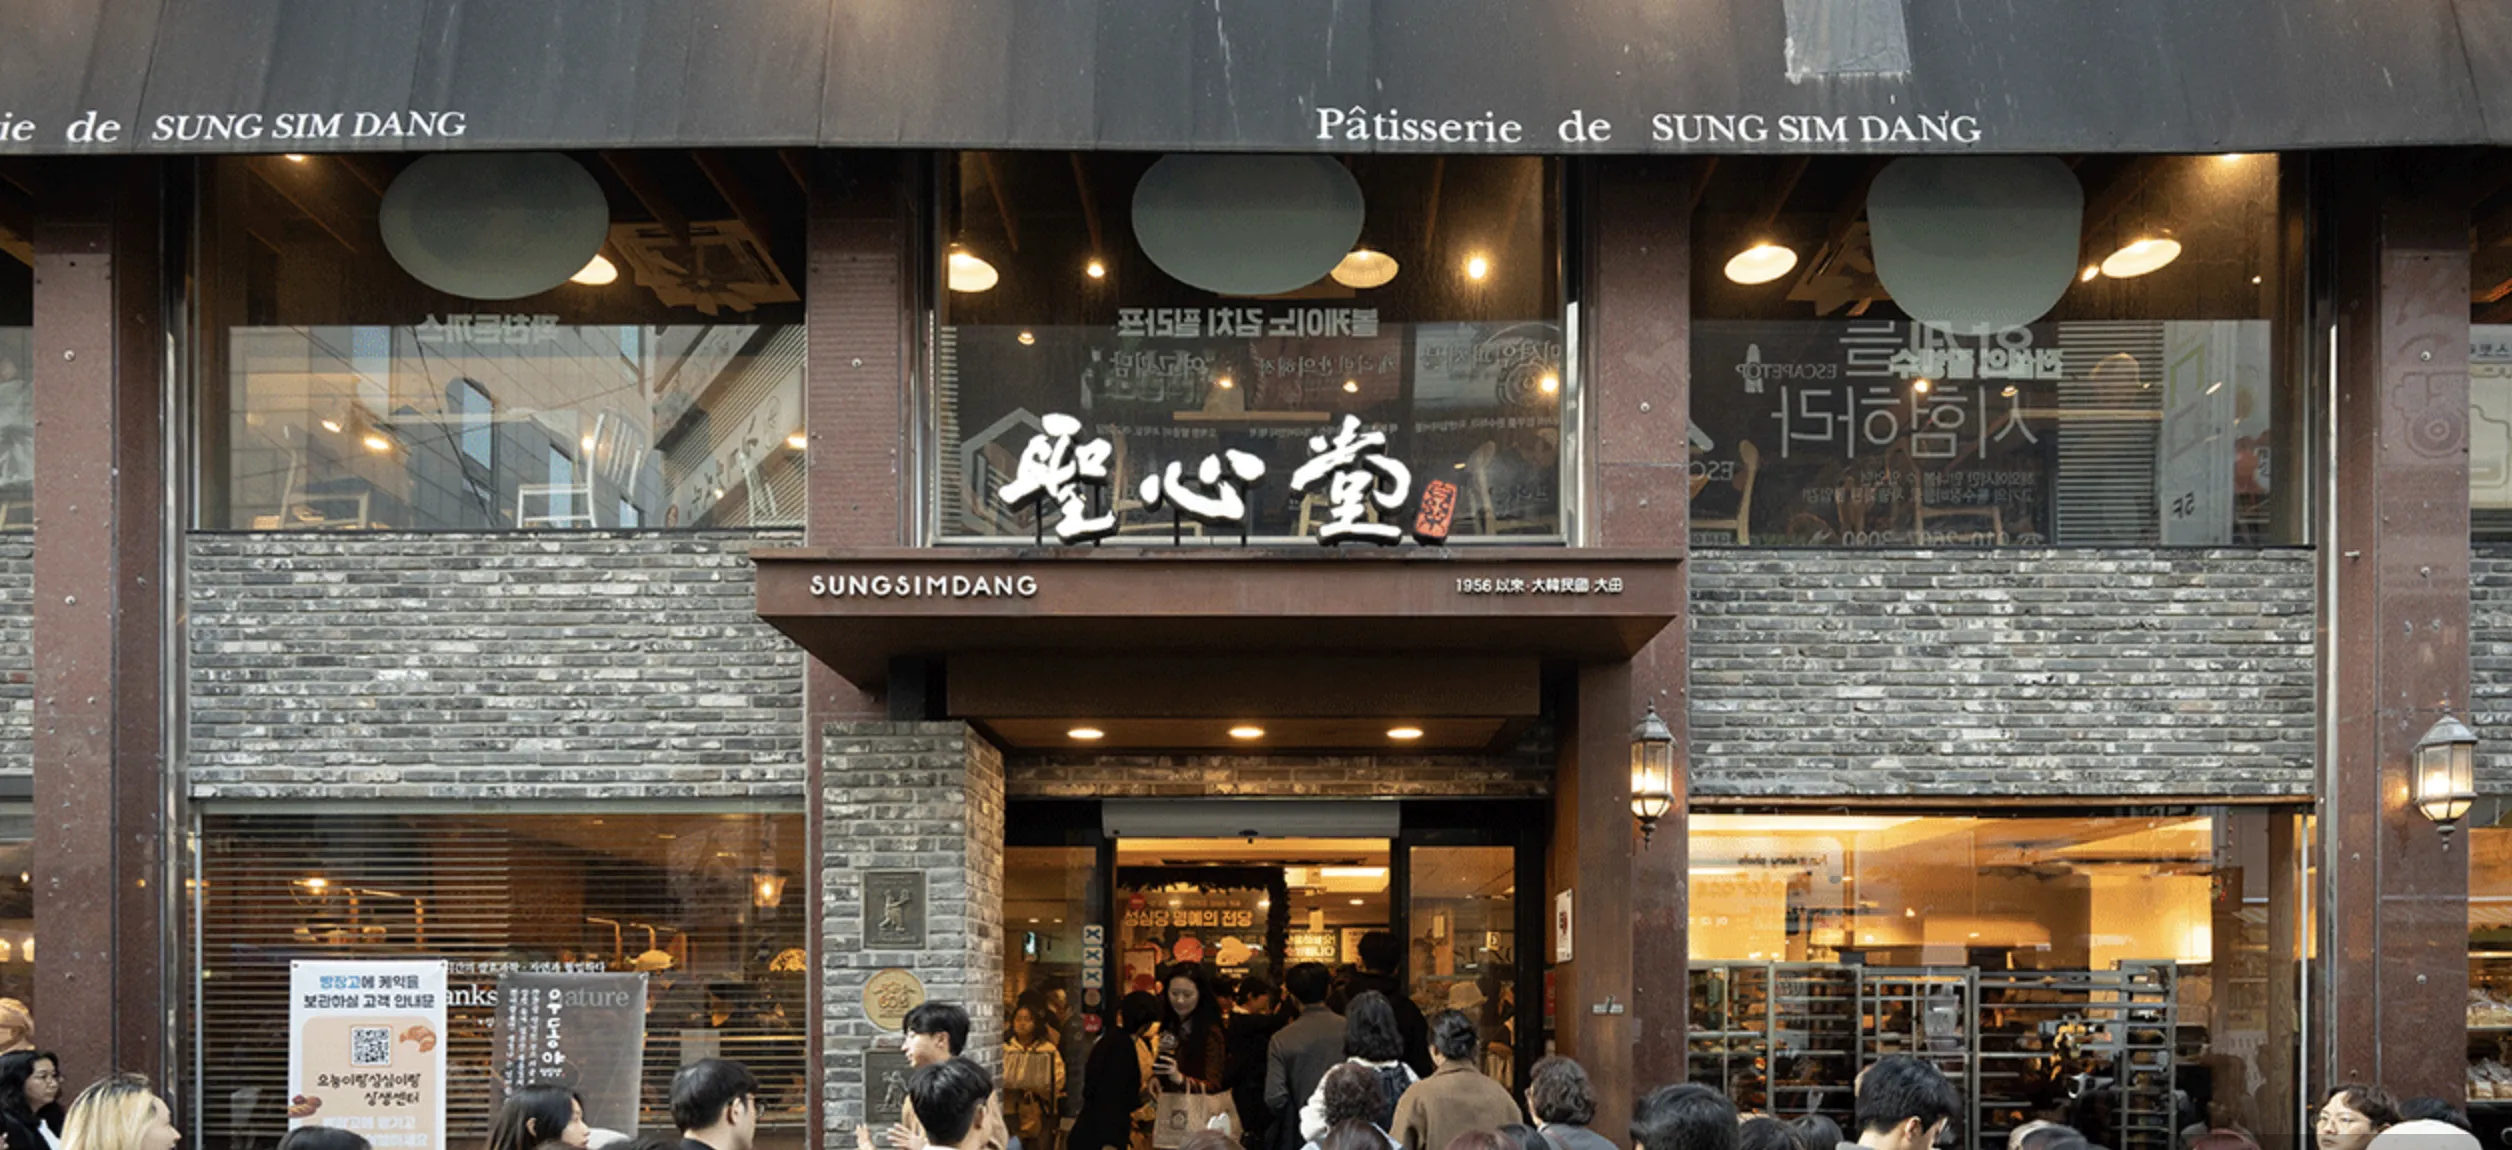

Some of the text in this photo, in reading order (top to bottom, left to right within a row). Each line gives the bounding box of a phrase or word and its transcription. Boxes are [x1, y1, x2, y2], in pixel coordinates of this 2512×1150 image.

[66, 110, 121, 144] de
[151, 113, 264, 142] SUNG
[271, 113, 344, 140] SIM
[351, 110, 467, 139] DANG
[1316, 105, 1982, 144] Pâtisserie de SUNG SIM DANG
[999, 413, 1413, 543] 聖心堂
[809, 574, 1038, 597] SUNGSIMDANG
[1456, 577, 1492, 593] 1956
[1123, 909, 1170, 928] 성심당
[1221, 909, 1253, 928] 전당
[319, 975, 420, 990] 빵장고에 케익을
[303, 994, 436, 1009] 보관하실 고객 안내문
[363, 1090, 420, 1108] 상생센터
